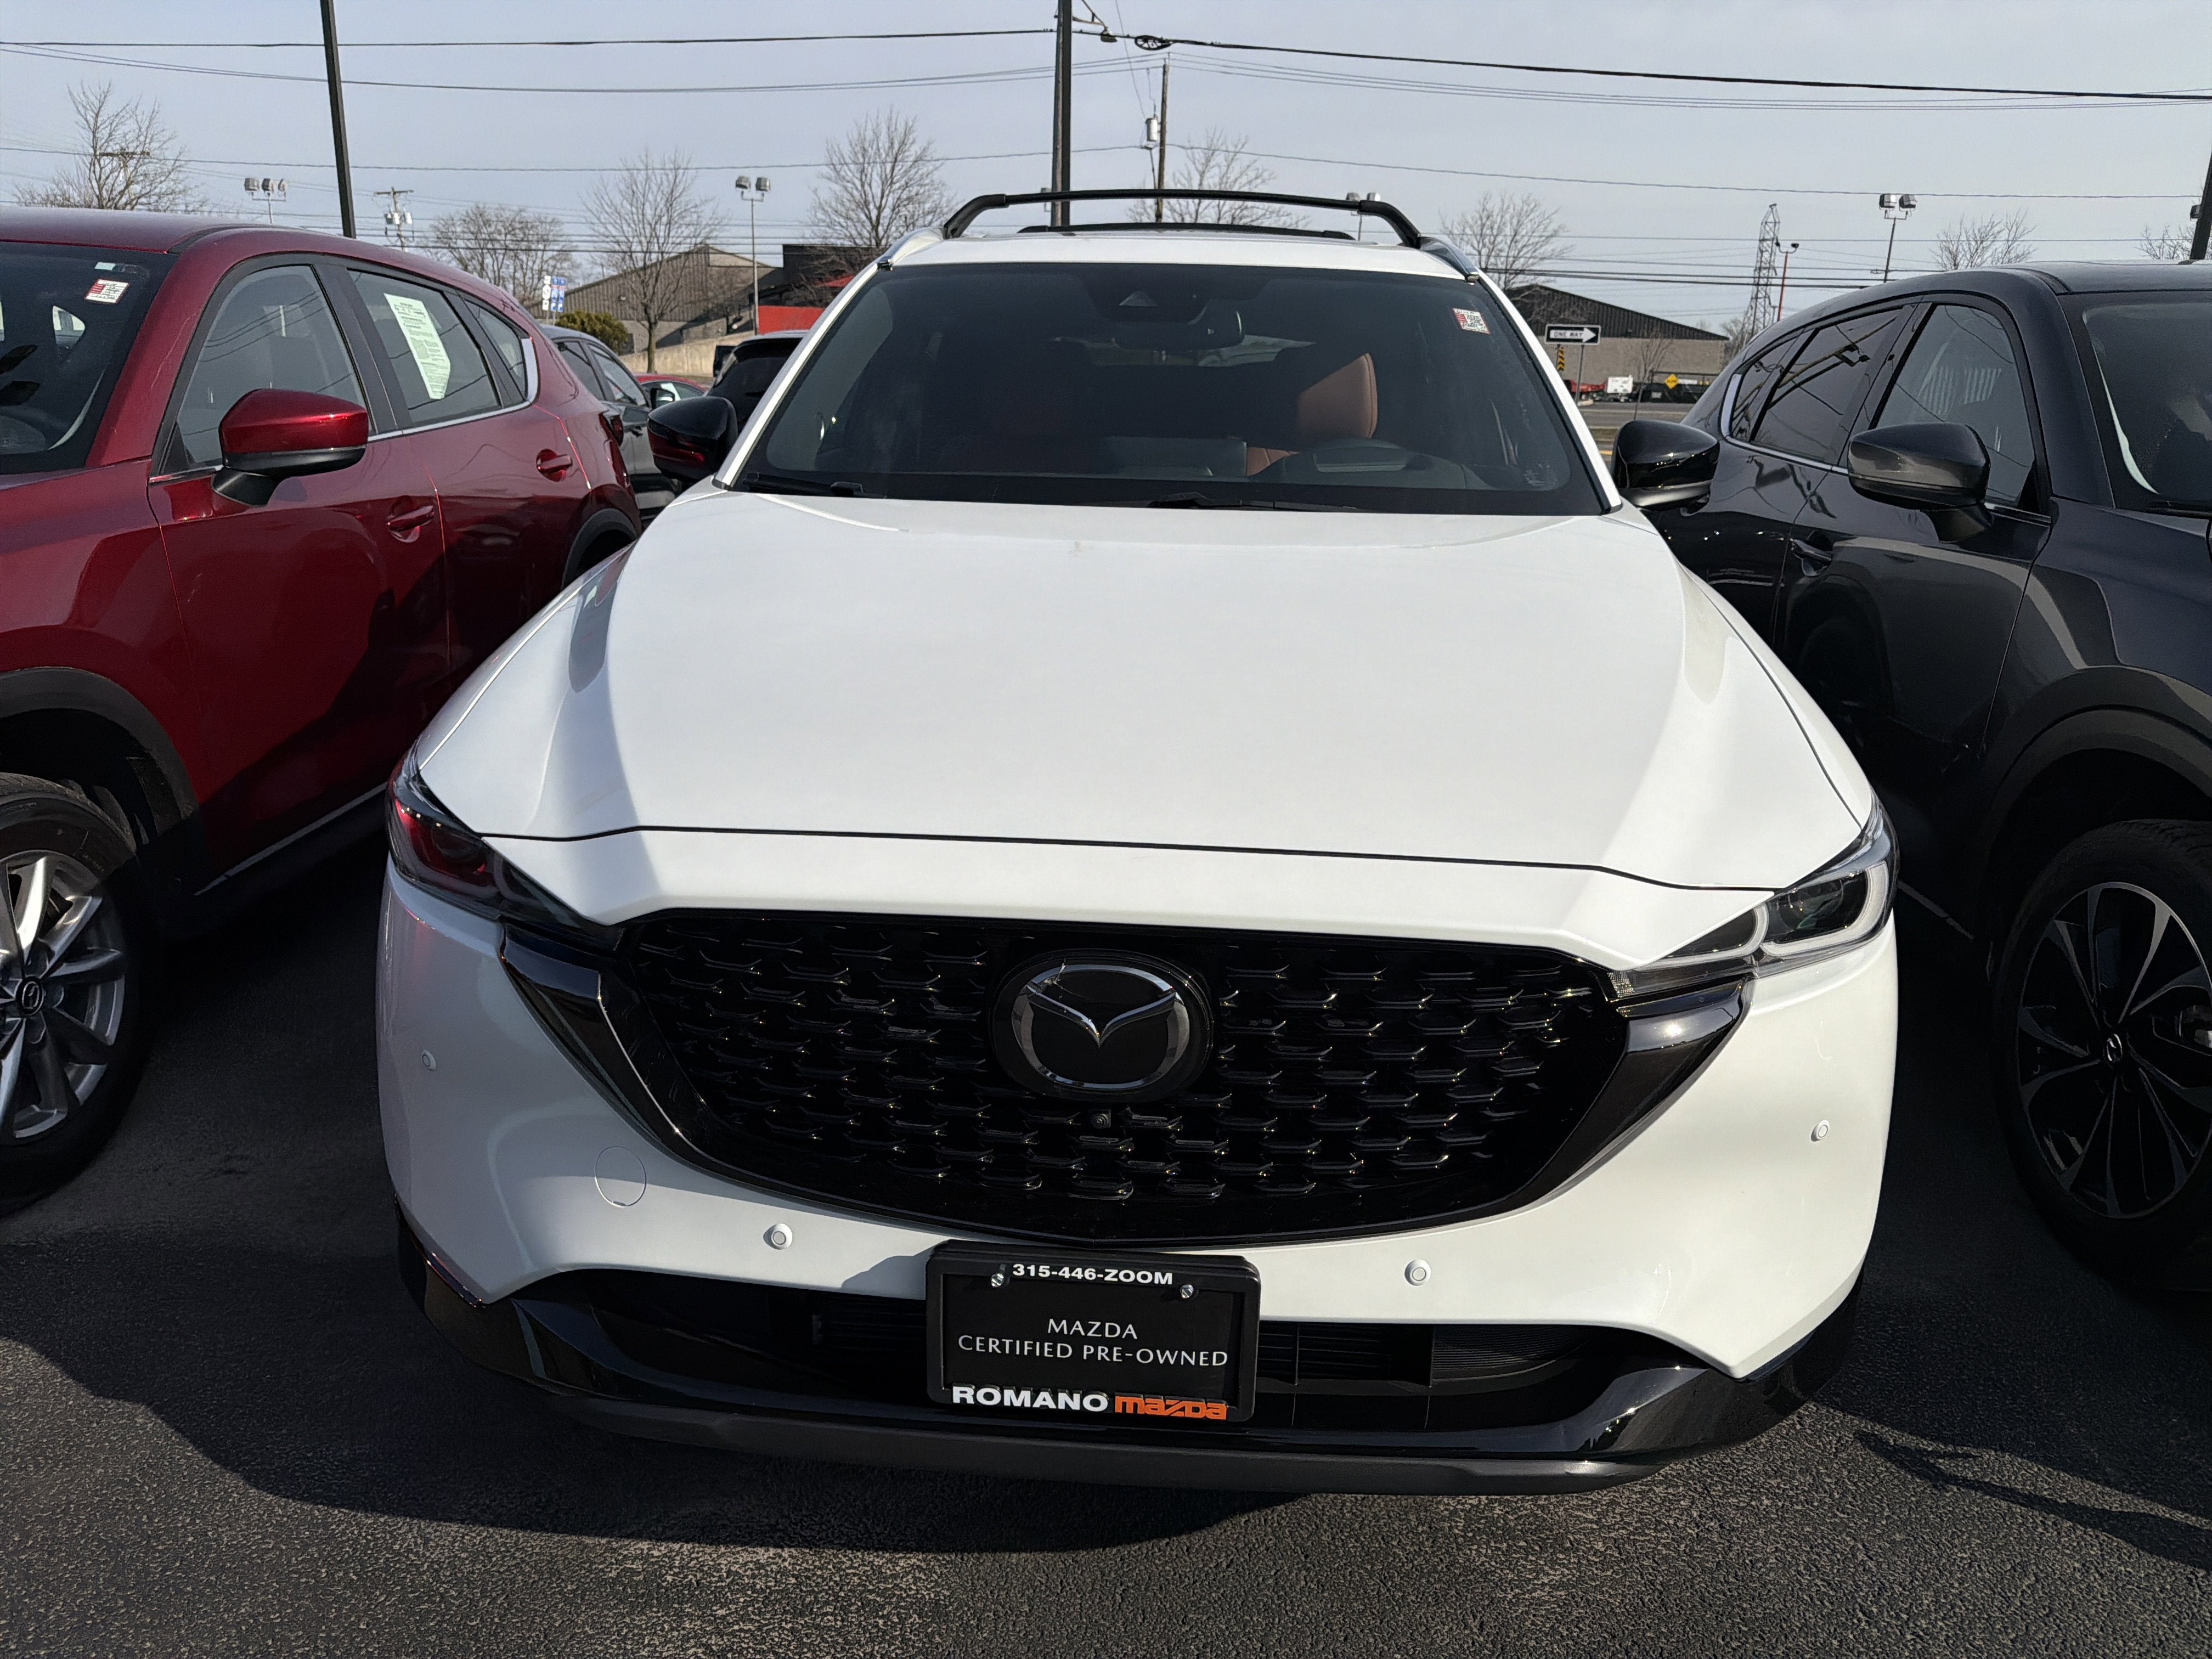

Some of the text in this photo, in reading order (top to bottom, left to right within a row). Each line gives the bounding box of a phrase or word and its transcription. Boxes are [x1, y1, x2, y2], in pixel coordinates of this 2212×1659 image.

[1012, 1263, 1172, 1285] 315-446-ZOOM
[1047, 1318, 1138, 1340] MAZDA
[958, 1335, 1228, 1366] CERTIFIED PRE-OWNED
[952, 1386, 1108, 1412] ROMANO
